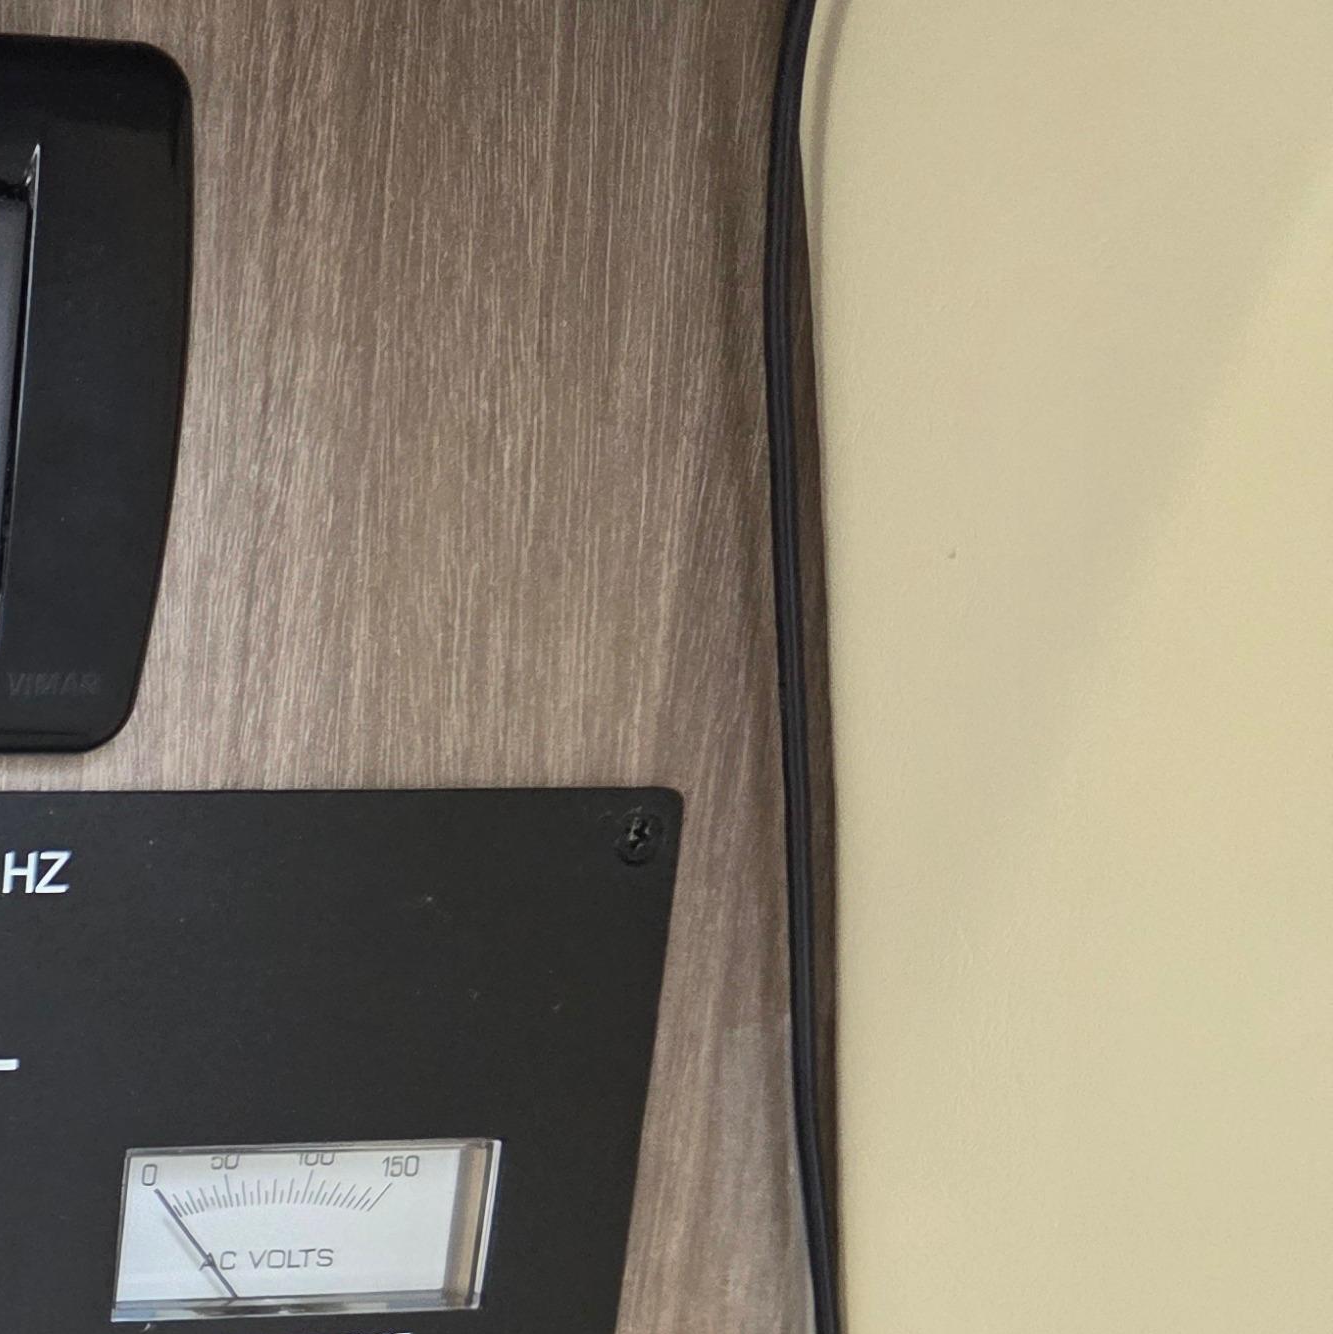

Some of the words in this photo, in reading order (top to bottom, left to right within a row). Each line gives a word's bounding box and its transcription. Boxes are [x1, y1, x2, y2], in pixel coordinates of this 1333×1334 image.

[6, 672, 101, 697] VIMAR
[3, 851, 71, 893] HZ
[141, 1164, 157, 1186] 0
[211, 1154, 239, 1170] 50
[382, 1155, 420, 1177] 150
[199, 1251, 236, 1271] AC
[249, 1248, 333, 1269] VOLTS
